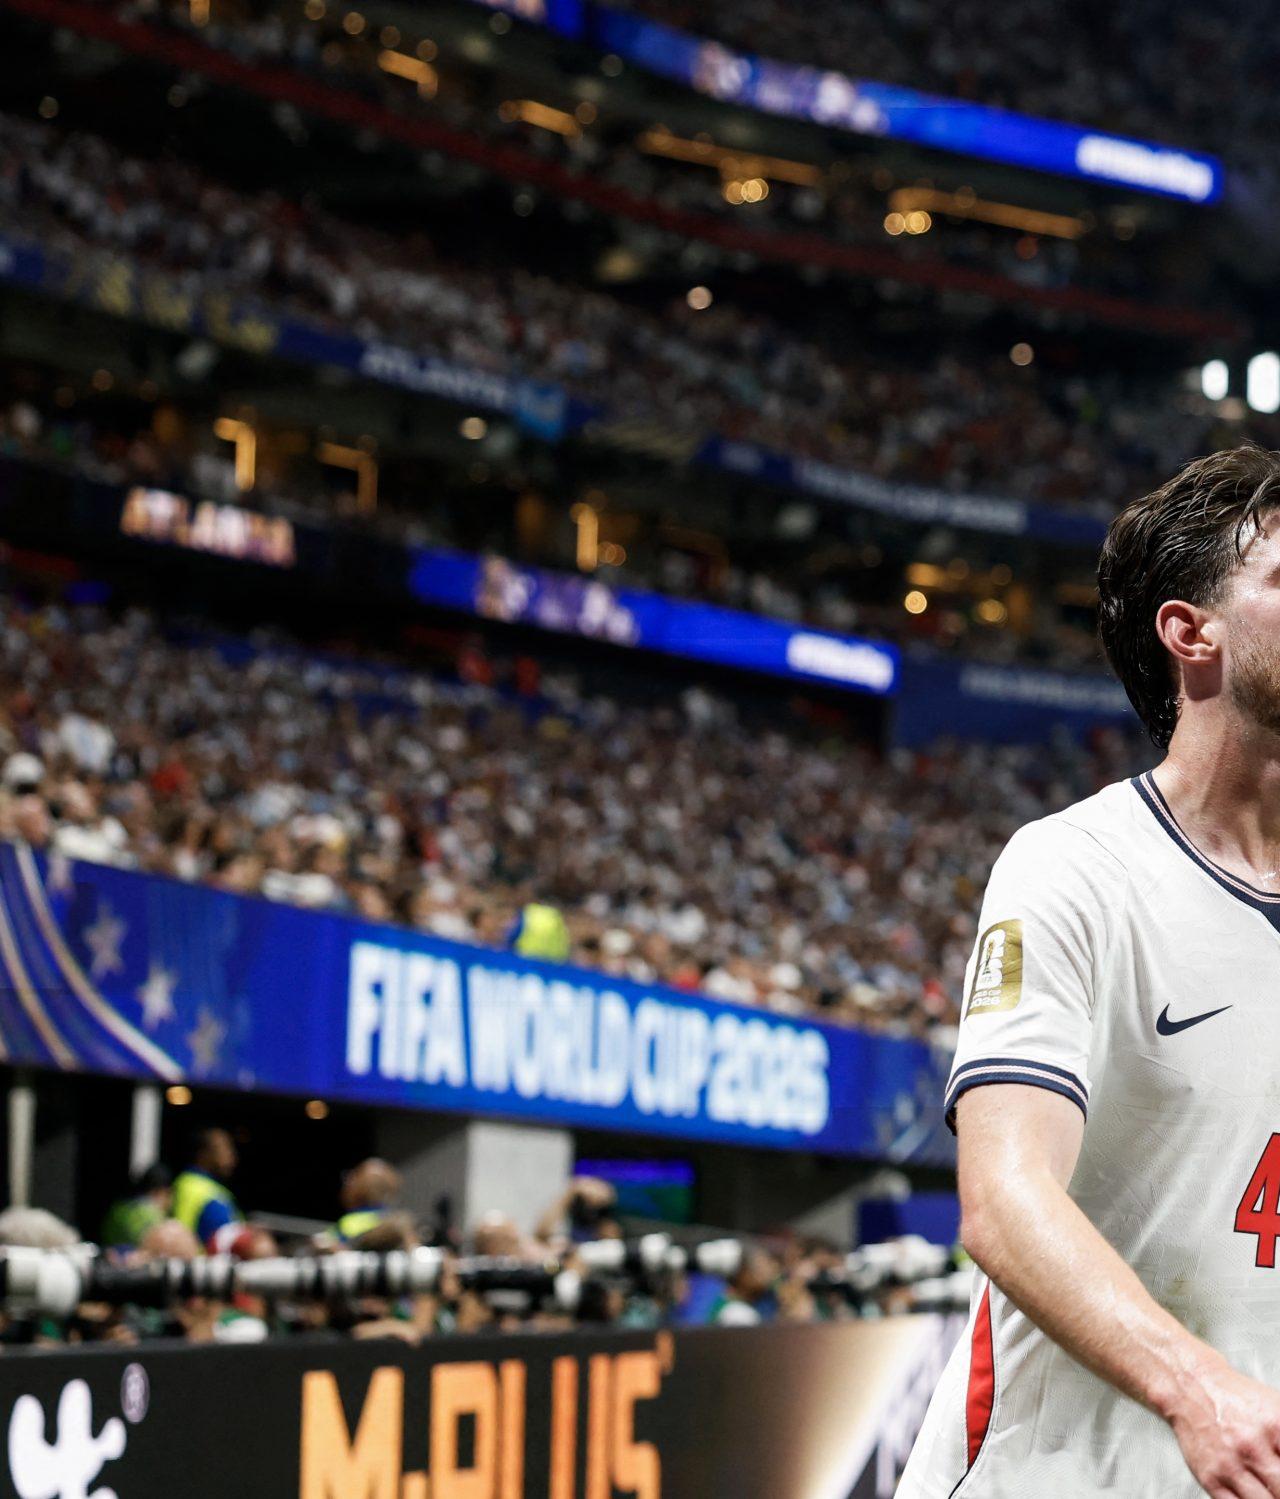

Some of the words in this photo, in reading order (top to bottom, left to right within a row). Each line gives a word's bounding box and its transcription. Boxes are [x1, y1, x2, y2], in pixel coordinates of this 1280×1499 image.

[347, 941, 467, 1088] FIFA
[468, 964, 632, 1108] WORLD
[632, 997, 712, 1119] CUP
[705, 1013, 830, 1135] 2026
